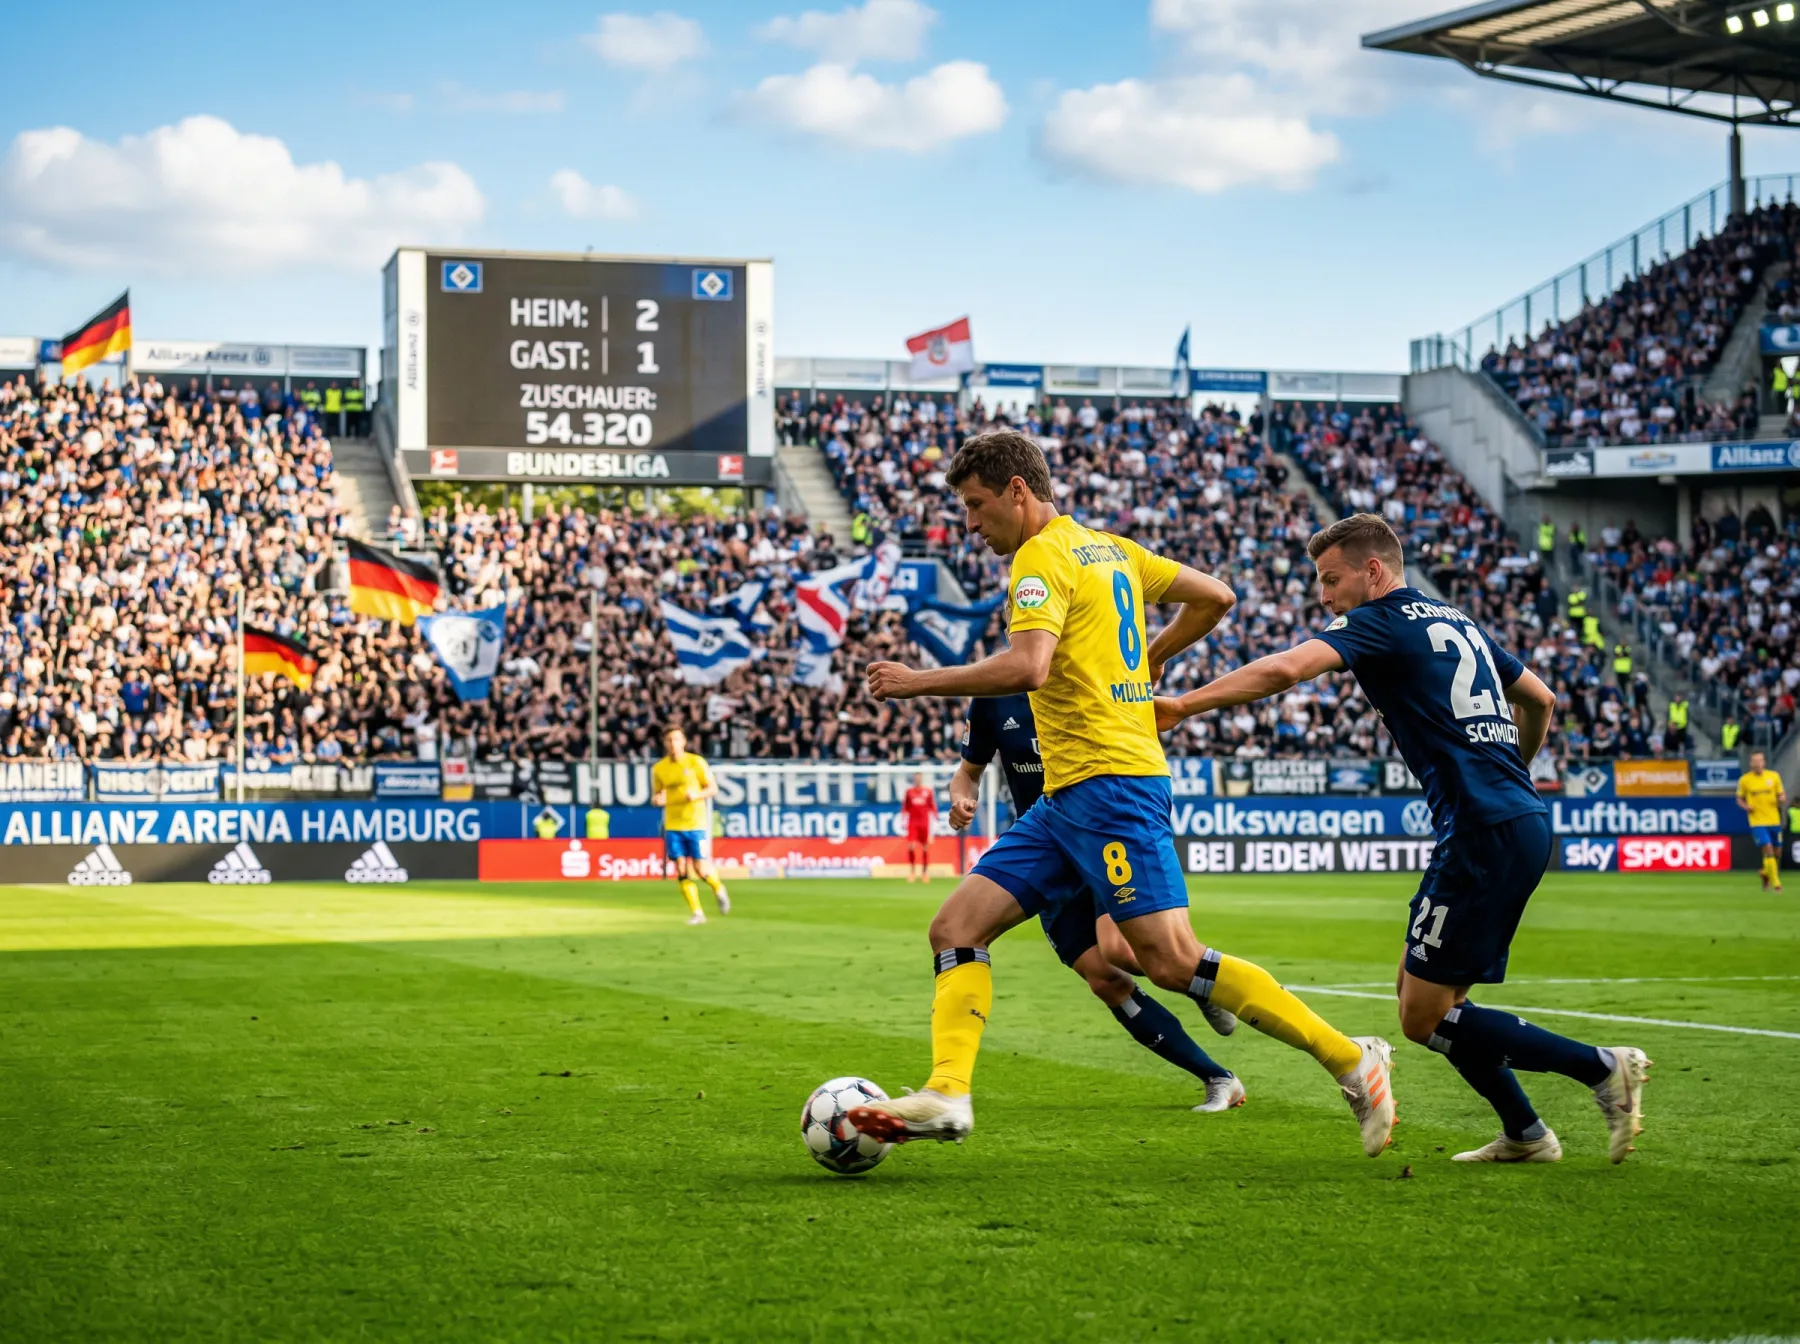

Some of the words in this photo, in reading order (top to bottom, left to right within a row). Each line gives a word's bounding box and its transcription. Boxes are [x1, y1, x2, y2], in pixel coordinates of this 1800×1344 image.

[510, 298, 589, 328] HEIM:
[635, 299, 659, 332] 2
[510, 340, 590, 370] GAST:
[637, 342, 660, 374] 1
[520, 385, 657, 411] ZUSCHAUER:
[526, 412, 652, 445] 54.320
[507, 452, 670, 478] BUNDESLIGA
[1718, 446, 1785, 466] Allianz
[1112, 569, 1141, 671] 8
[1425, 622, 1513, 721] 21
[4, 809, 159, 844] ALLIANZ
[166, 808, 293, 843] ARENA
[302, 808, 481, 842] HAMBURG
[1171, 802, 1385, 838] Volkswagen
[1552, 801, 1718, 833] Lufthansa
[1103, 841, 1132, 886] 8
[1188, 841, 1234, 872] BEI
[1240, 841, 1335, 872] JEDEM
[1565, 837, 1615, 872] sky
[1623, 840, 1725, 867] SPORT
[1411, 896, 1449, 948] 21
